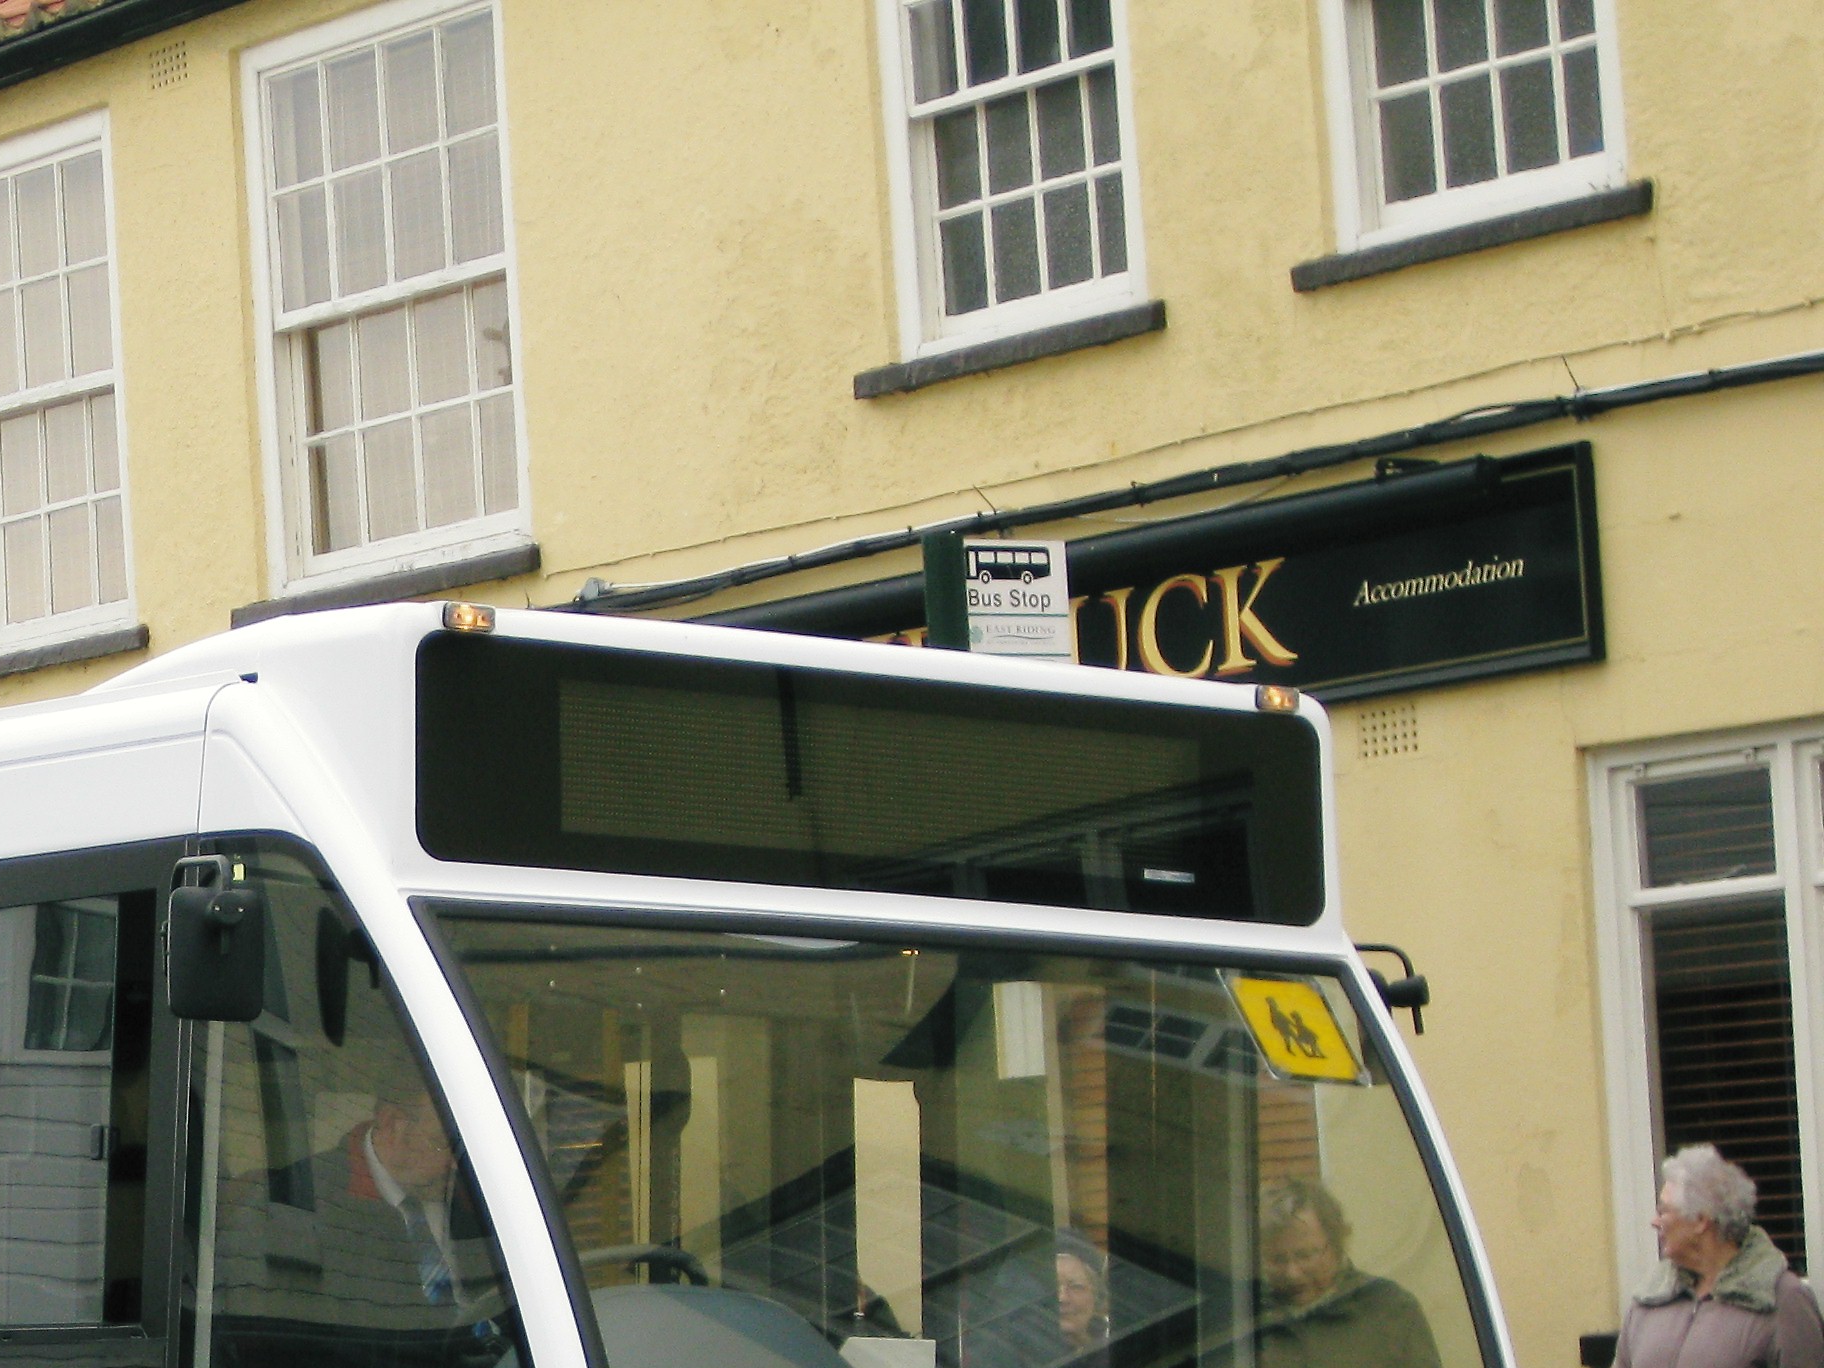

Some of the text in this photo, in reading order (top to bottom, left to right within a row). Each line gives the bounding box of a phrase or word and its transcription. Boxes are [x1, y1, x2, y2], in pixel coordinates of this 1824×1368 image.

[968, 588, 1051, 612] Bus Stop
[1353, 555, 1525, 607] Accommodation
[986, 624, 1013, 634] EAST
[1069, 556, 1299, 677] UCK
